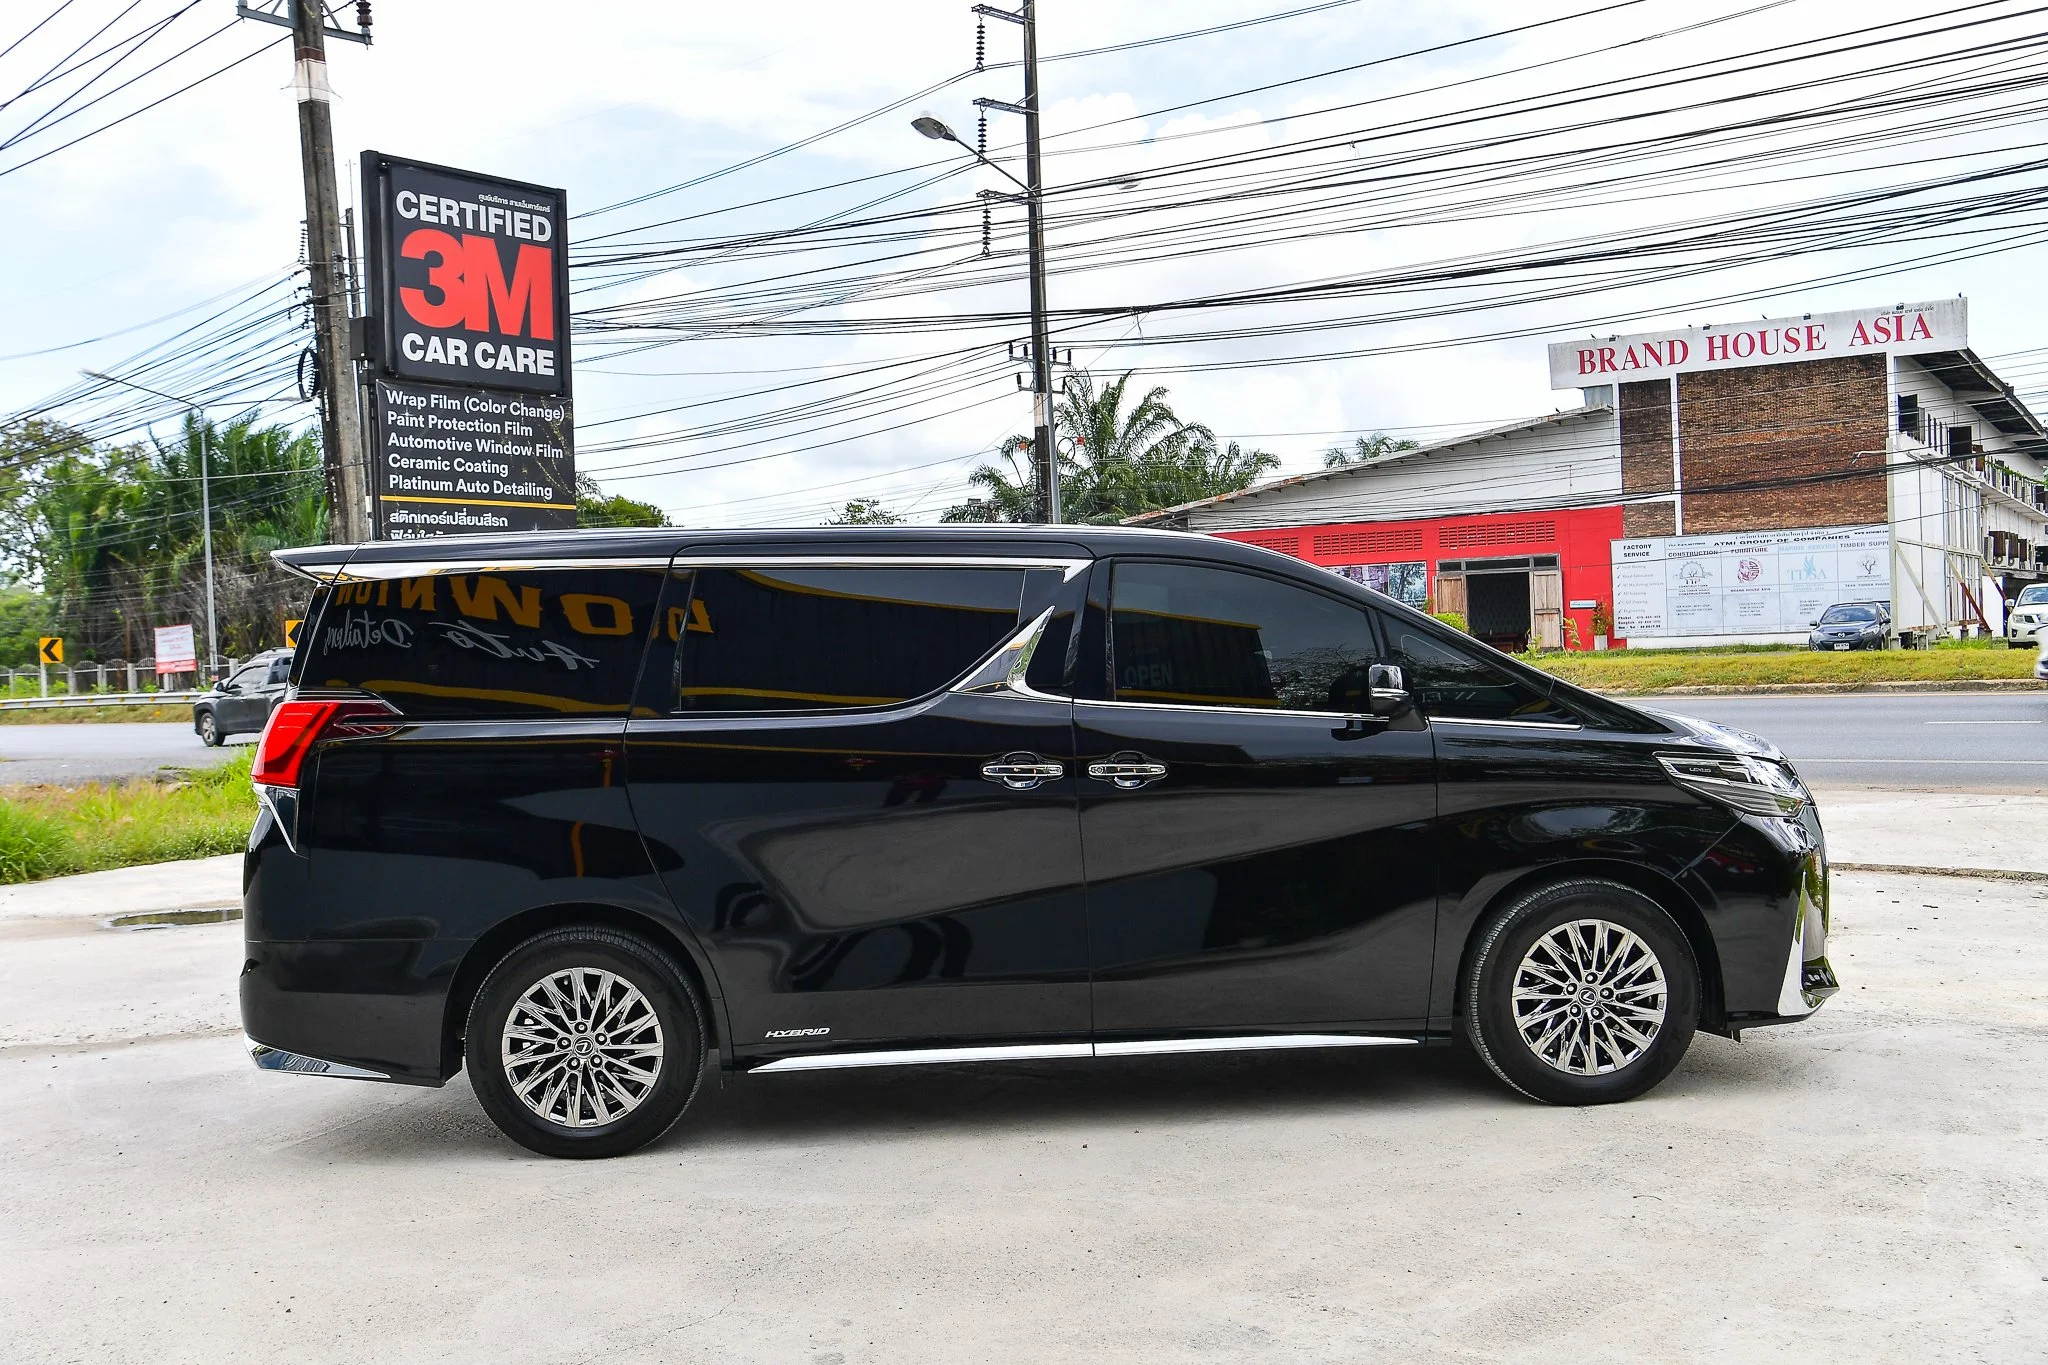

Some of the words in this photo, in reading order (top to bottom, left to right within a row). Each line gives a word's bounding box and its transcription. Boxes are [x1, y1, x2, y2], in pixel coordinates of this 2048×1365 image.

[395, 190, 552, 242] CERTIFIED
[399, 228, 554, 341] 3M
[402, 332, 468, 367] CAR
[474, 341, 555, 377] CARE
[1577, 338, 1689, 376] BRAND
[1706, 323, 1827, 362] HOUSE
[1848, 312, 1934, 348] ASIA
[386, 389, 427, 408] Wrap
[430, 394, 461, 411] Film
[463, 396, 508, 416] (Color
[509, 401, 565, 422] Change)
[387, 411, 425, 428] Paint
[428, 414, 501, 434] Protection
[504, 421, 533, 437] Film
[387, 432, 473, 452] Automotive
[475, 438, 532, 457] Window
[535, 443, 564, 459] Film
[388, 453, 451, 471] Ceramic
[453, 457, 509, 478] Coating
[389, 474, 453, 492] Platinum
[456, 478, 490, 494] Auto
[493, 481, 553, 501] Detailing
[765, 1027, 831, 1038] HYBRID
